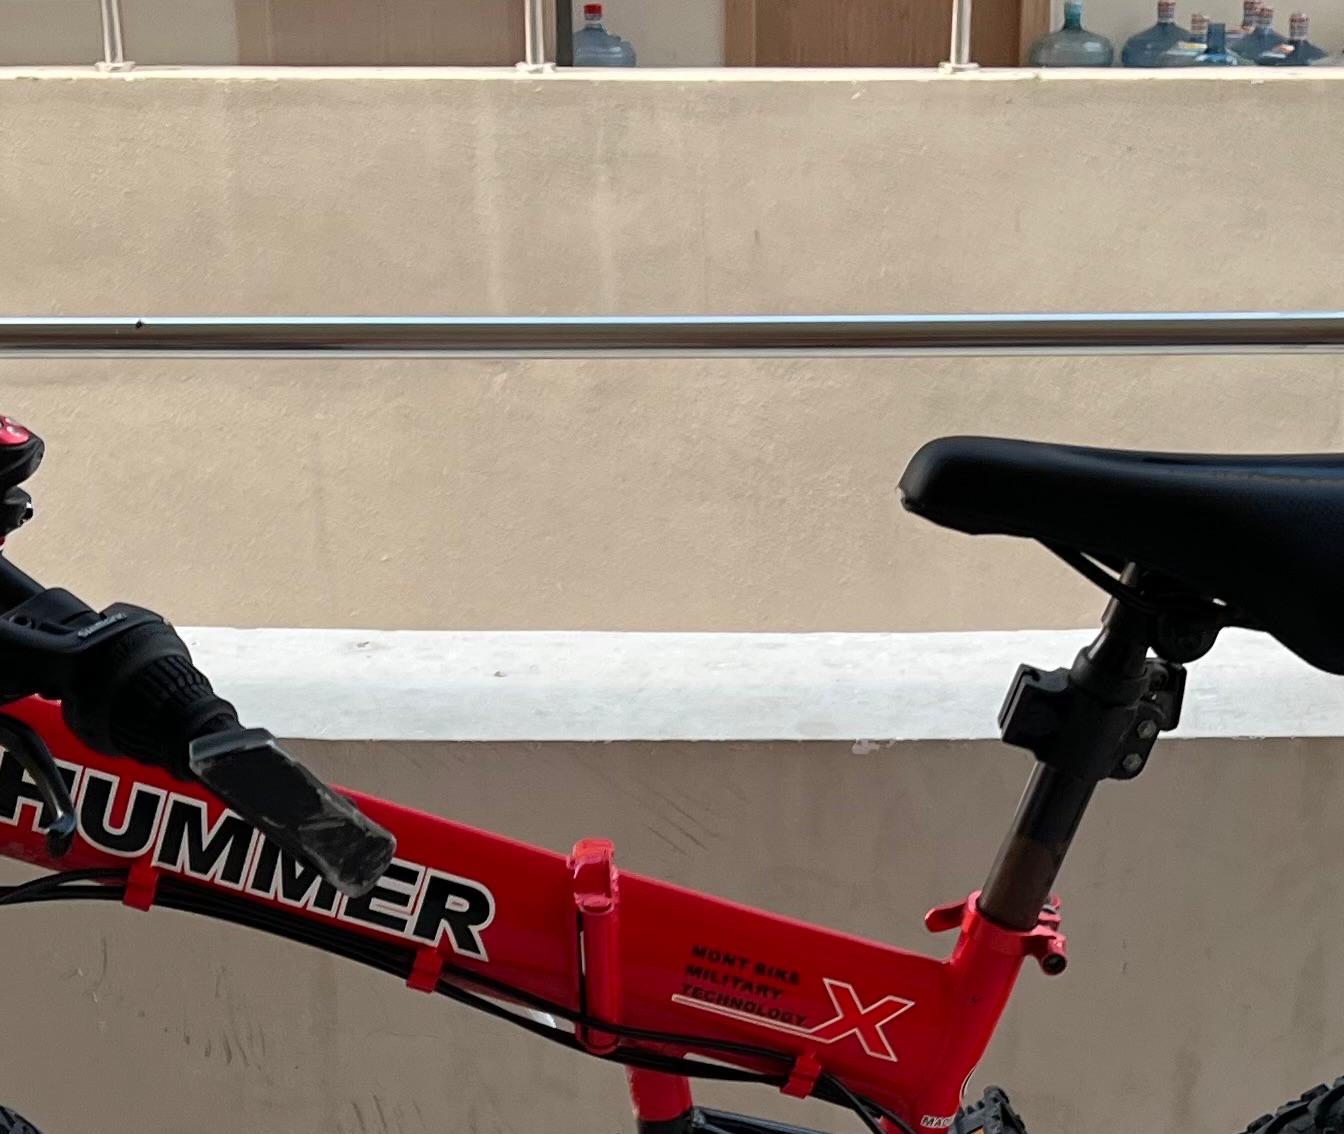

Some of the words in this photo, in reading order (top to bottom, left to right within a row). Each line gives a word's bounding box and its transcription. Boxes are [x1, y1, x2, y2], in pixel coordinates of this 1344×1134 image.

[686, 965, 784, 999] MILITARY
[754, 962, 799, 985] BIKE
[682, 982, 808, 1026] TECHNOLOGY
